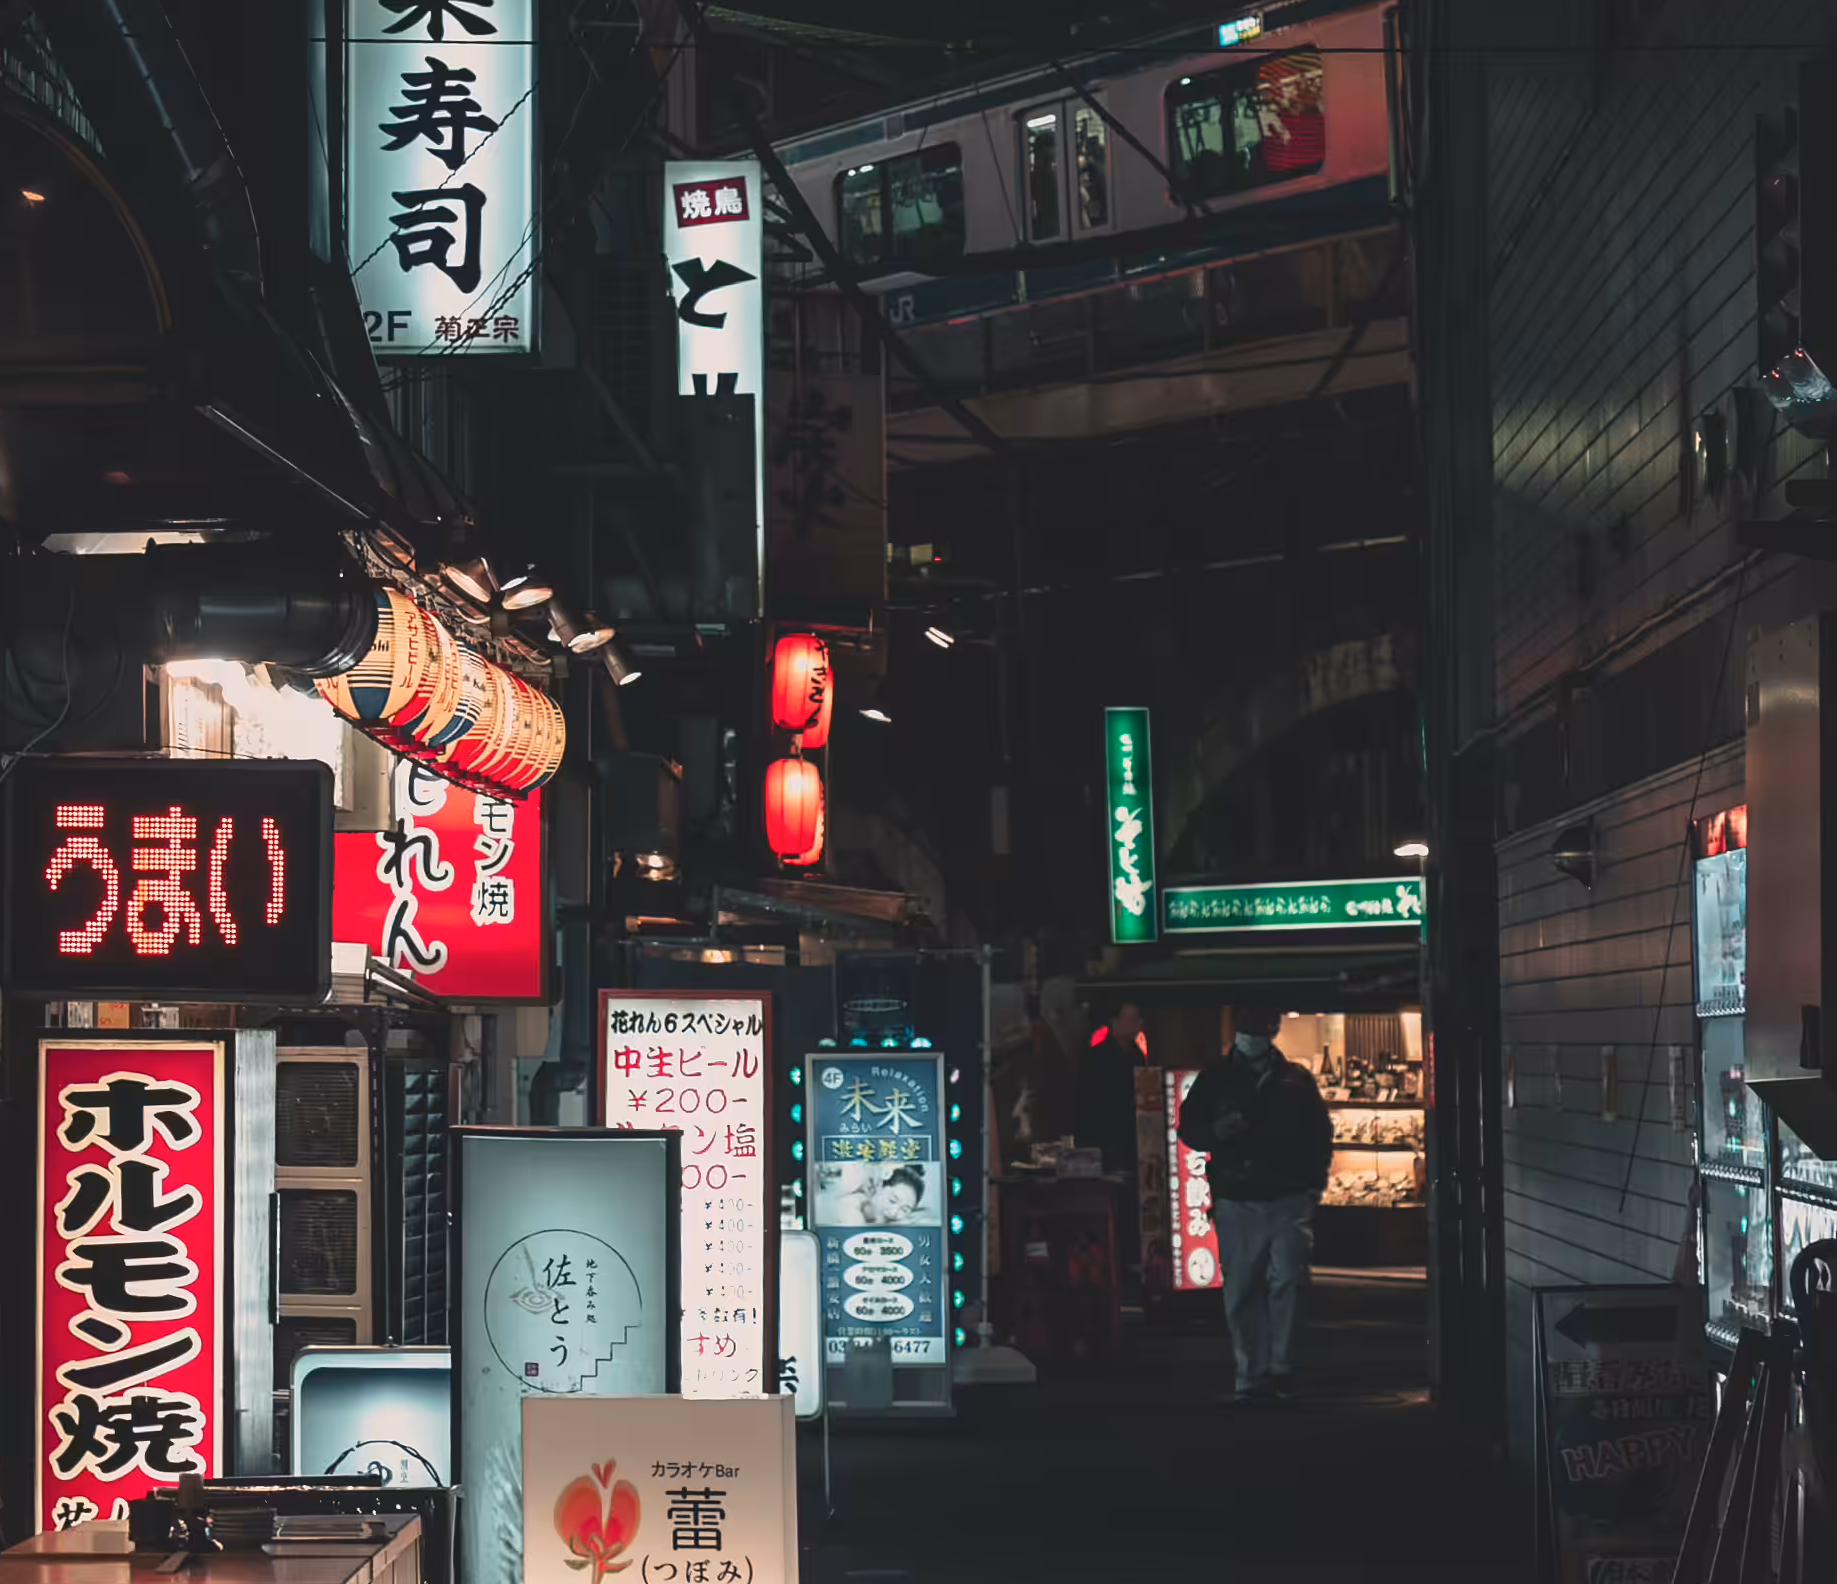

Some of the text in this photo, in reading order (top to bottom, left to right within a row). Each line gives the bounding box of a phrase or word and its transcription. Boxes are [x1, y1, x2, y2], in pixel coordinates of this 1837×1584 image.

[681, 186, 743, 219] 焼鳥
[434, 314, 521, 344] 菊正宗
[45, 805, 285, 955] うまい
[613, 1045, 759, 1079] 中生ビール
[823, 1072, 842, 1085] 4F
[839, 1075, 924, 1135] 未来
[871, 1066, 929, 1112] Relaxation
[839, 1123, 873, 1134] みらい
[52, 1074, 204, 1478] ホルモン焼
[542, 1253, 578, 1368] 佐とう
[893, 1340, 931, 1354] 6477
[650, 1460, 741, 1480] カラオケBar
[664, 1485, 728, 1552] 蕾
